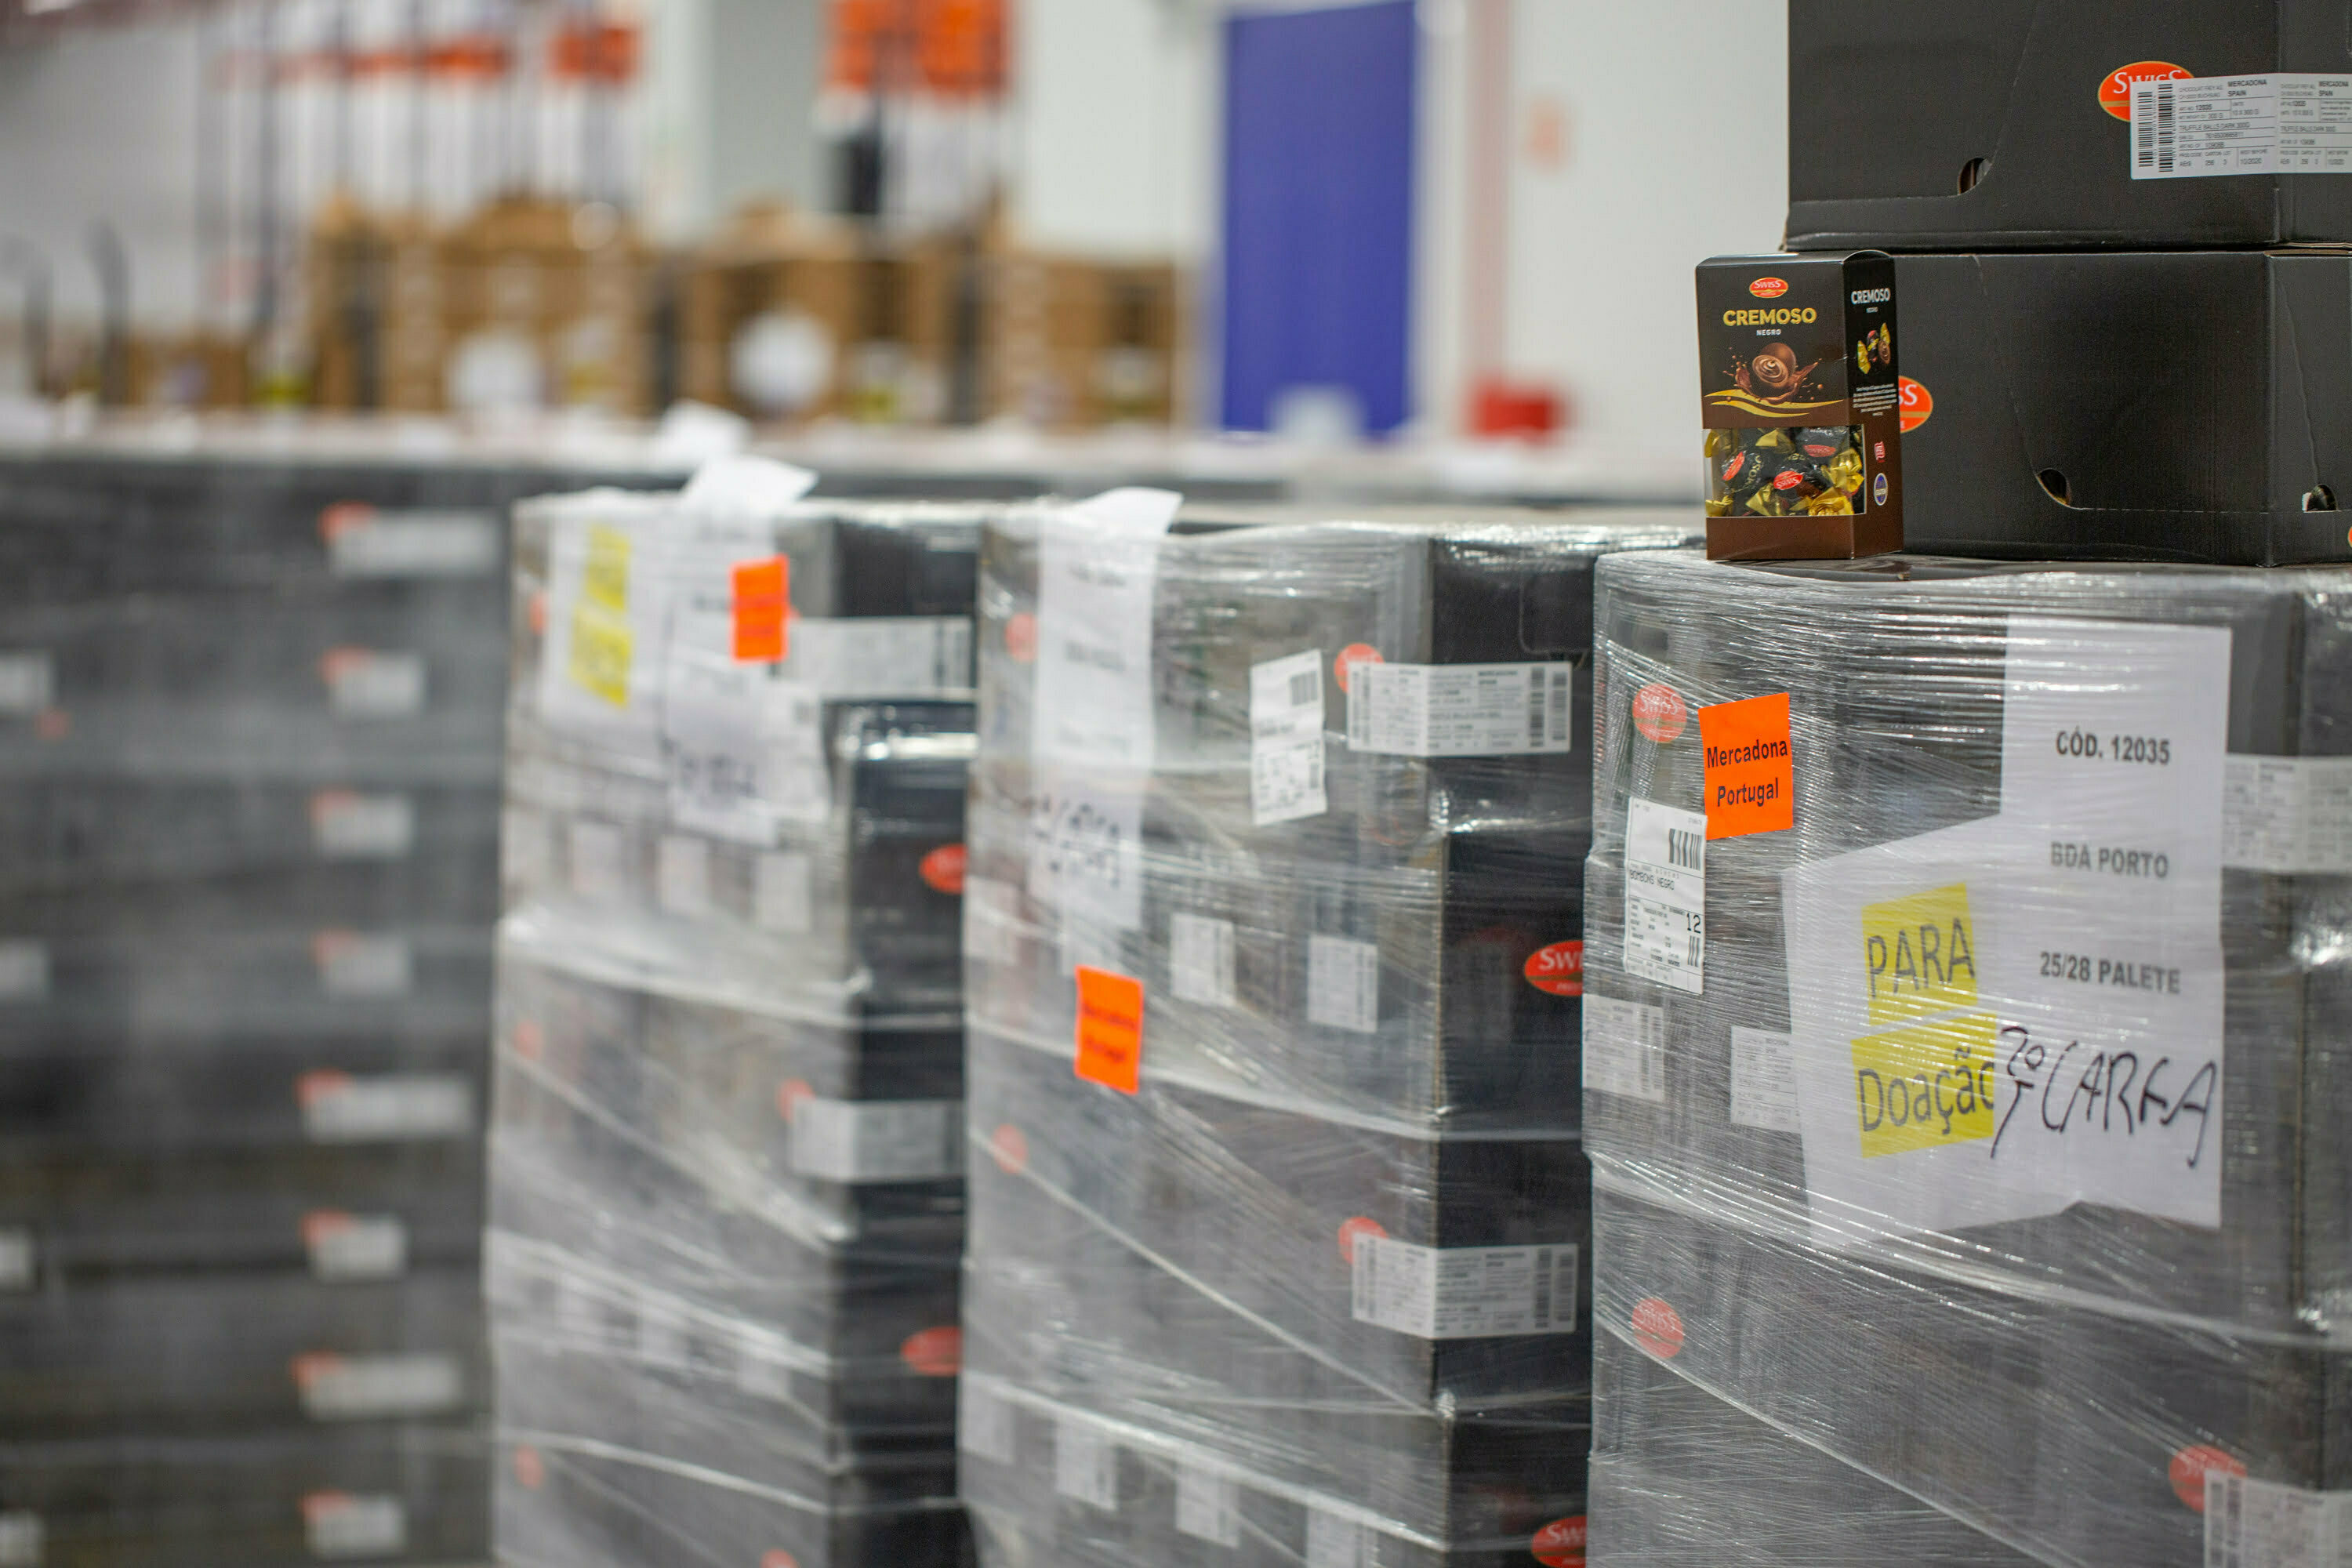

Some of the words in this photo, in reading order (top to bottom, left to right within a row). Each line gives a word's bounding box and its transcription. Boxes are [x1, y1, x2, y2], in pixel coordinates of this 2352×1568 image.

[1851, 288, 1891, 304] CREMOSO
[1722, 307, 1817, 326] CREMOSO
[1708, 739, 1788, 768] Mercadona
[2056, 726, 2103, 758] CÓD.
[2111, 734, 2170, 765] 12035
[1717, 778, 1778, 808] Portugal
[2098, 848, 2169, 879] PORTO
[1687, 913, 1701, 934] 12
[1867, 917, 1976, 1000] PARA
[2041, 951, 2091, 983] 25/28
[2099, 959, 2181, 995] PALETE
